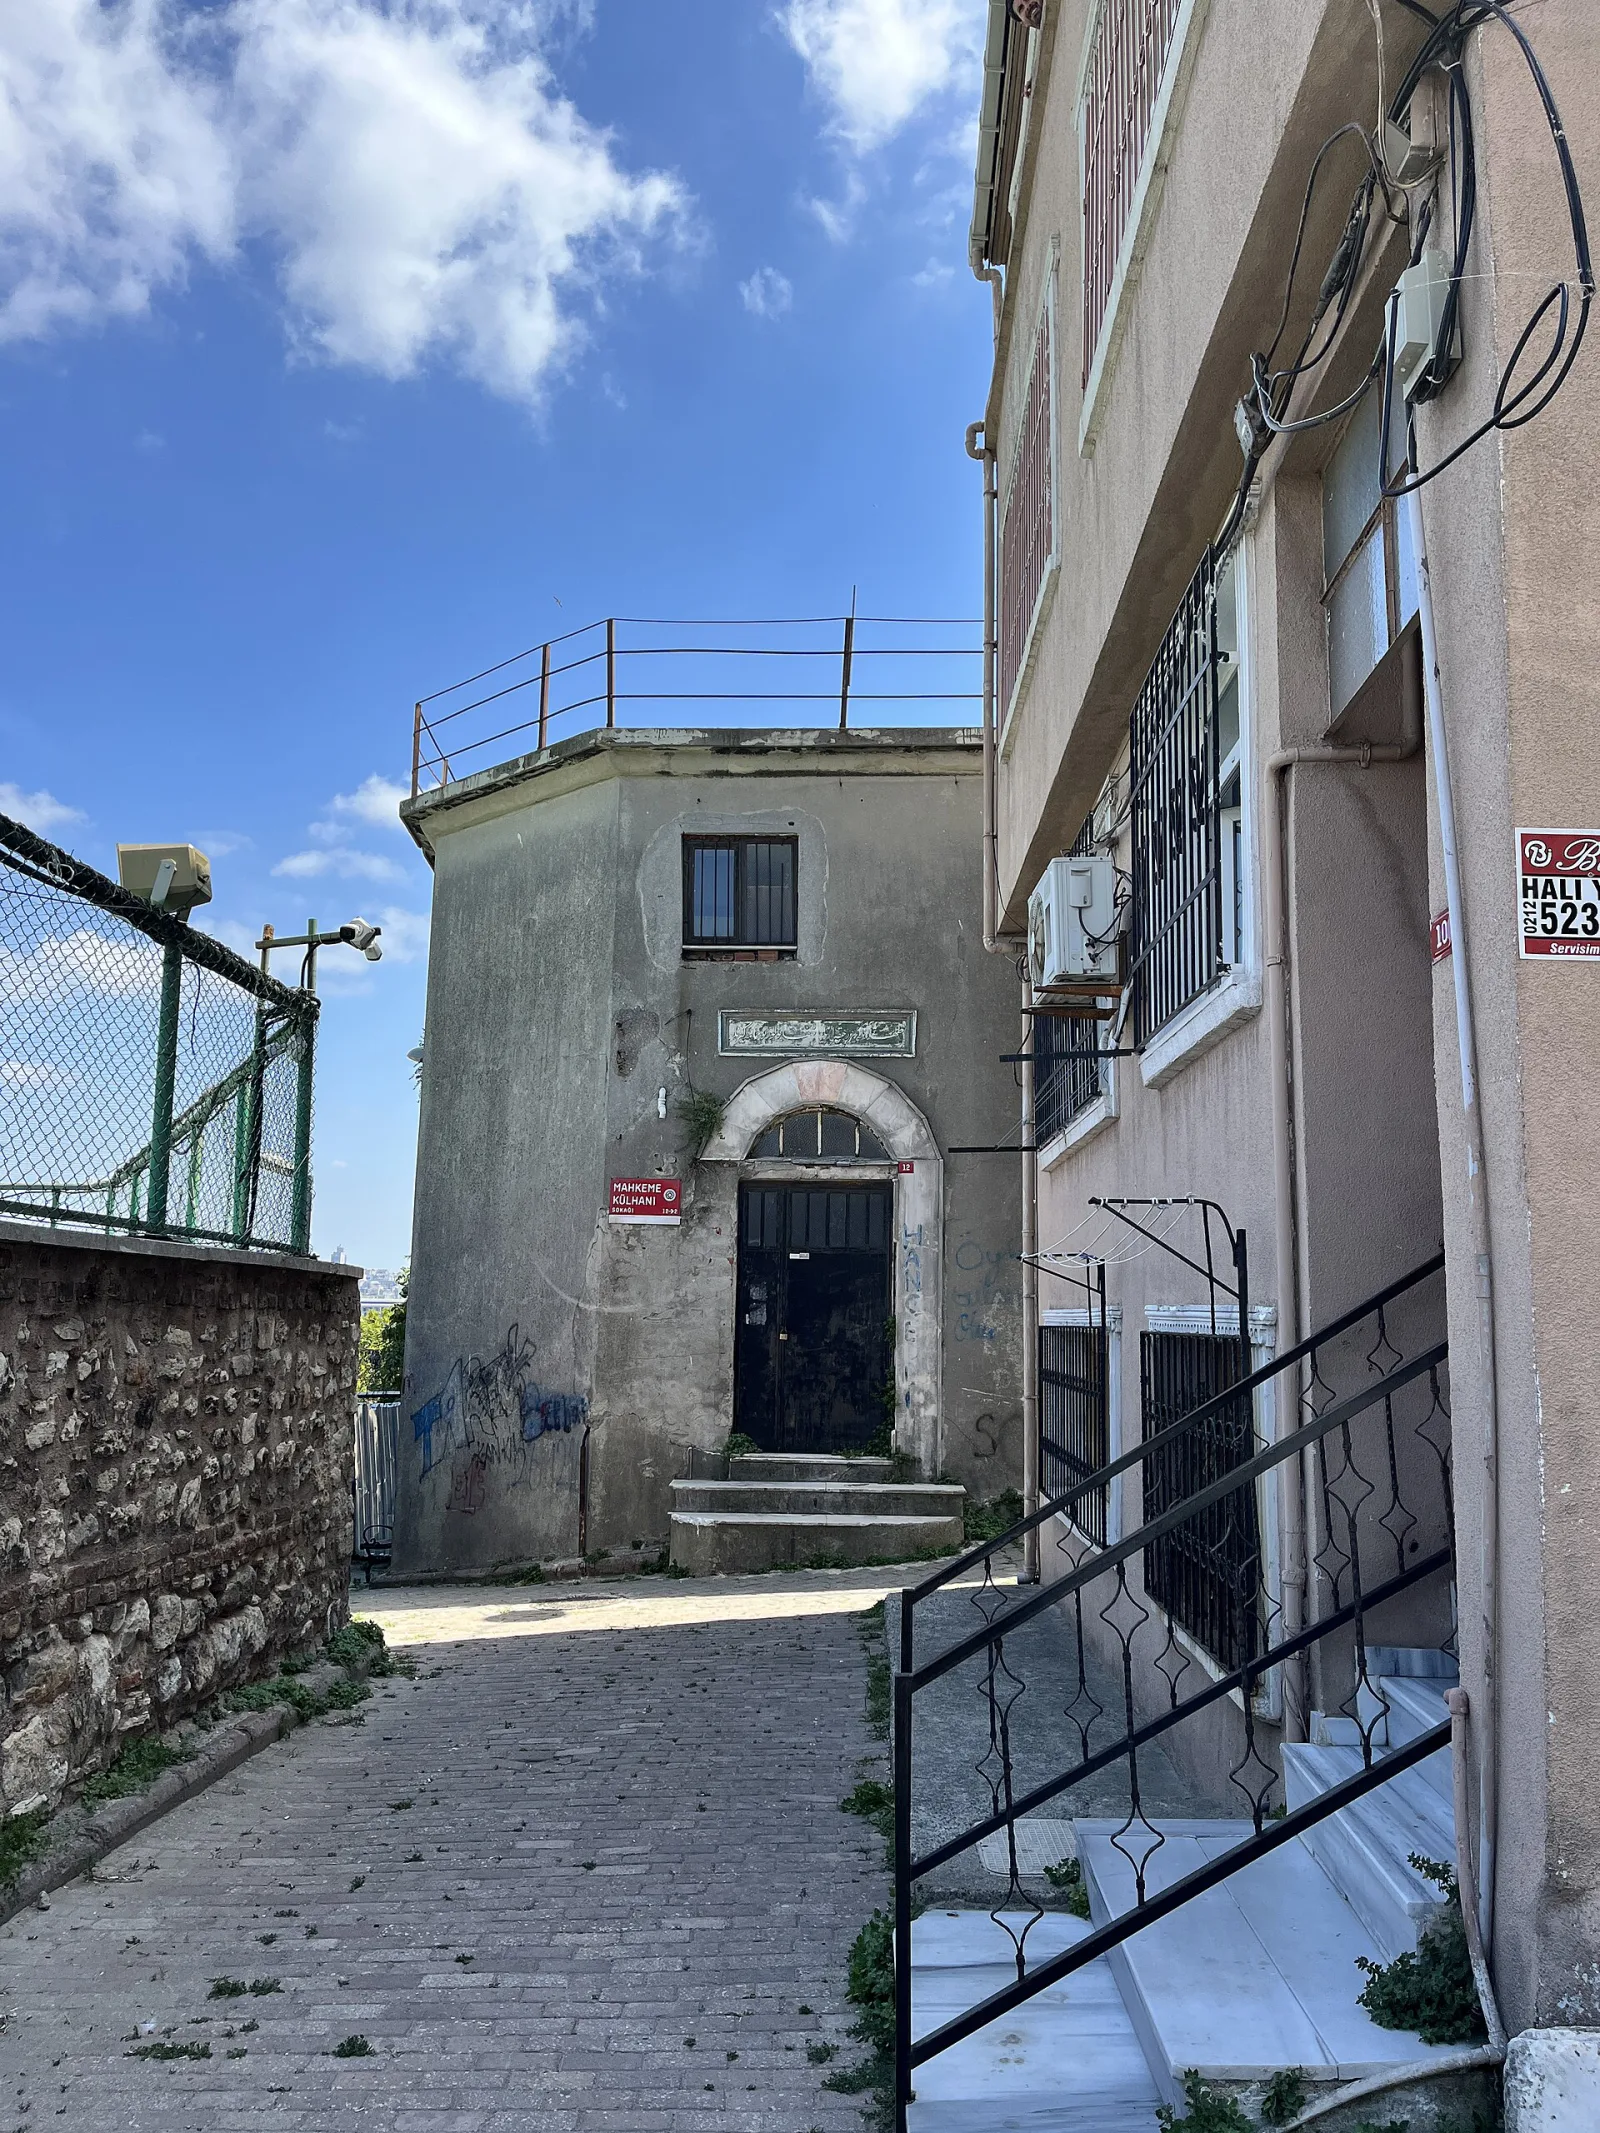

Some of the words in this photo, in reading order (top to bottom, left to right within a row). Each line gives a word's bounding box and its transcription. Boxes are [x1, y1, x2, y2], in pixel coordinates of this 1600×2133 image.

[1522, 878, 1582, 901] HALI
[1523, 901, 1537, 934] 0212
[1540, 901, 1599, 936] 523
[1435, 919, 1448, 949] 10
[902, 1163, 911, 1171] 12
[613, 1182, 662, 1193] MAHKEME
[612, 1193, 656, 1206] KÜLHANI
